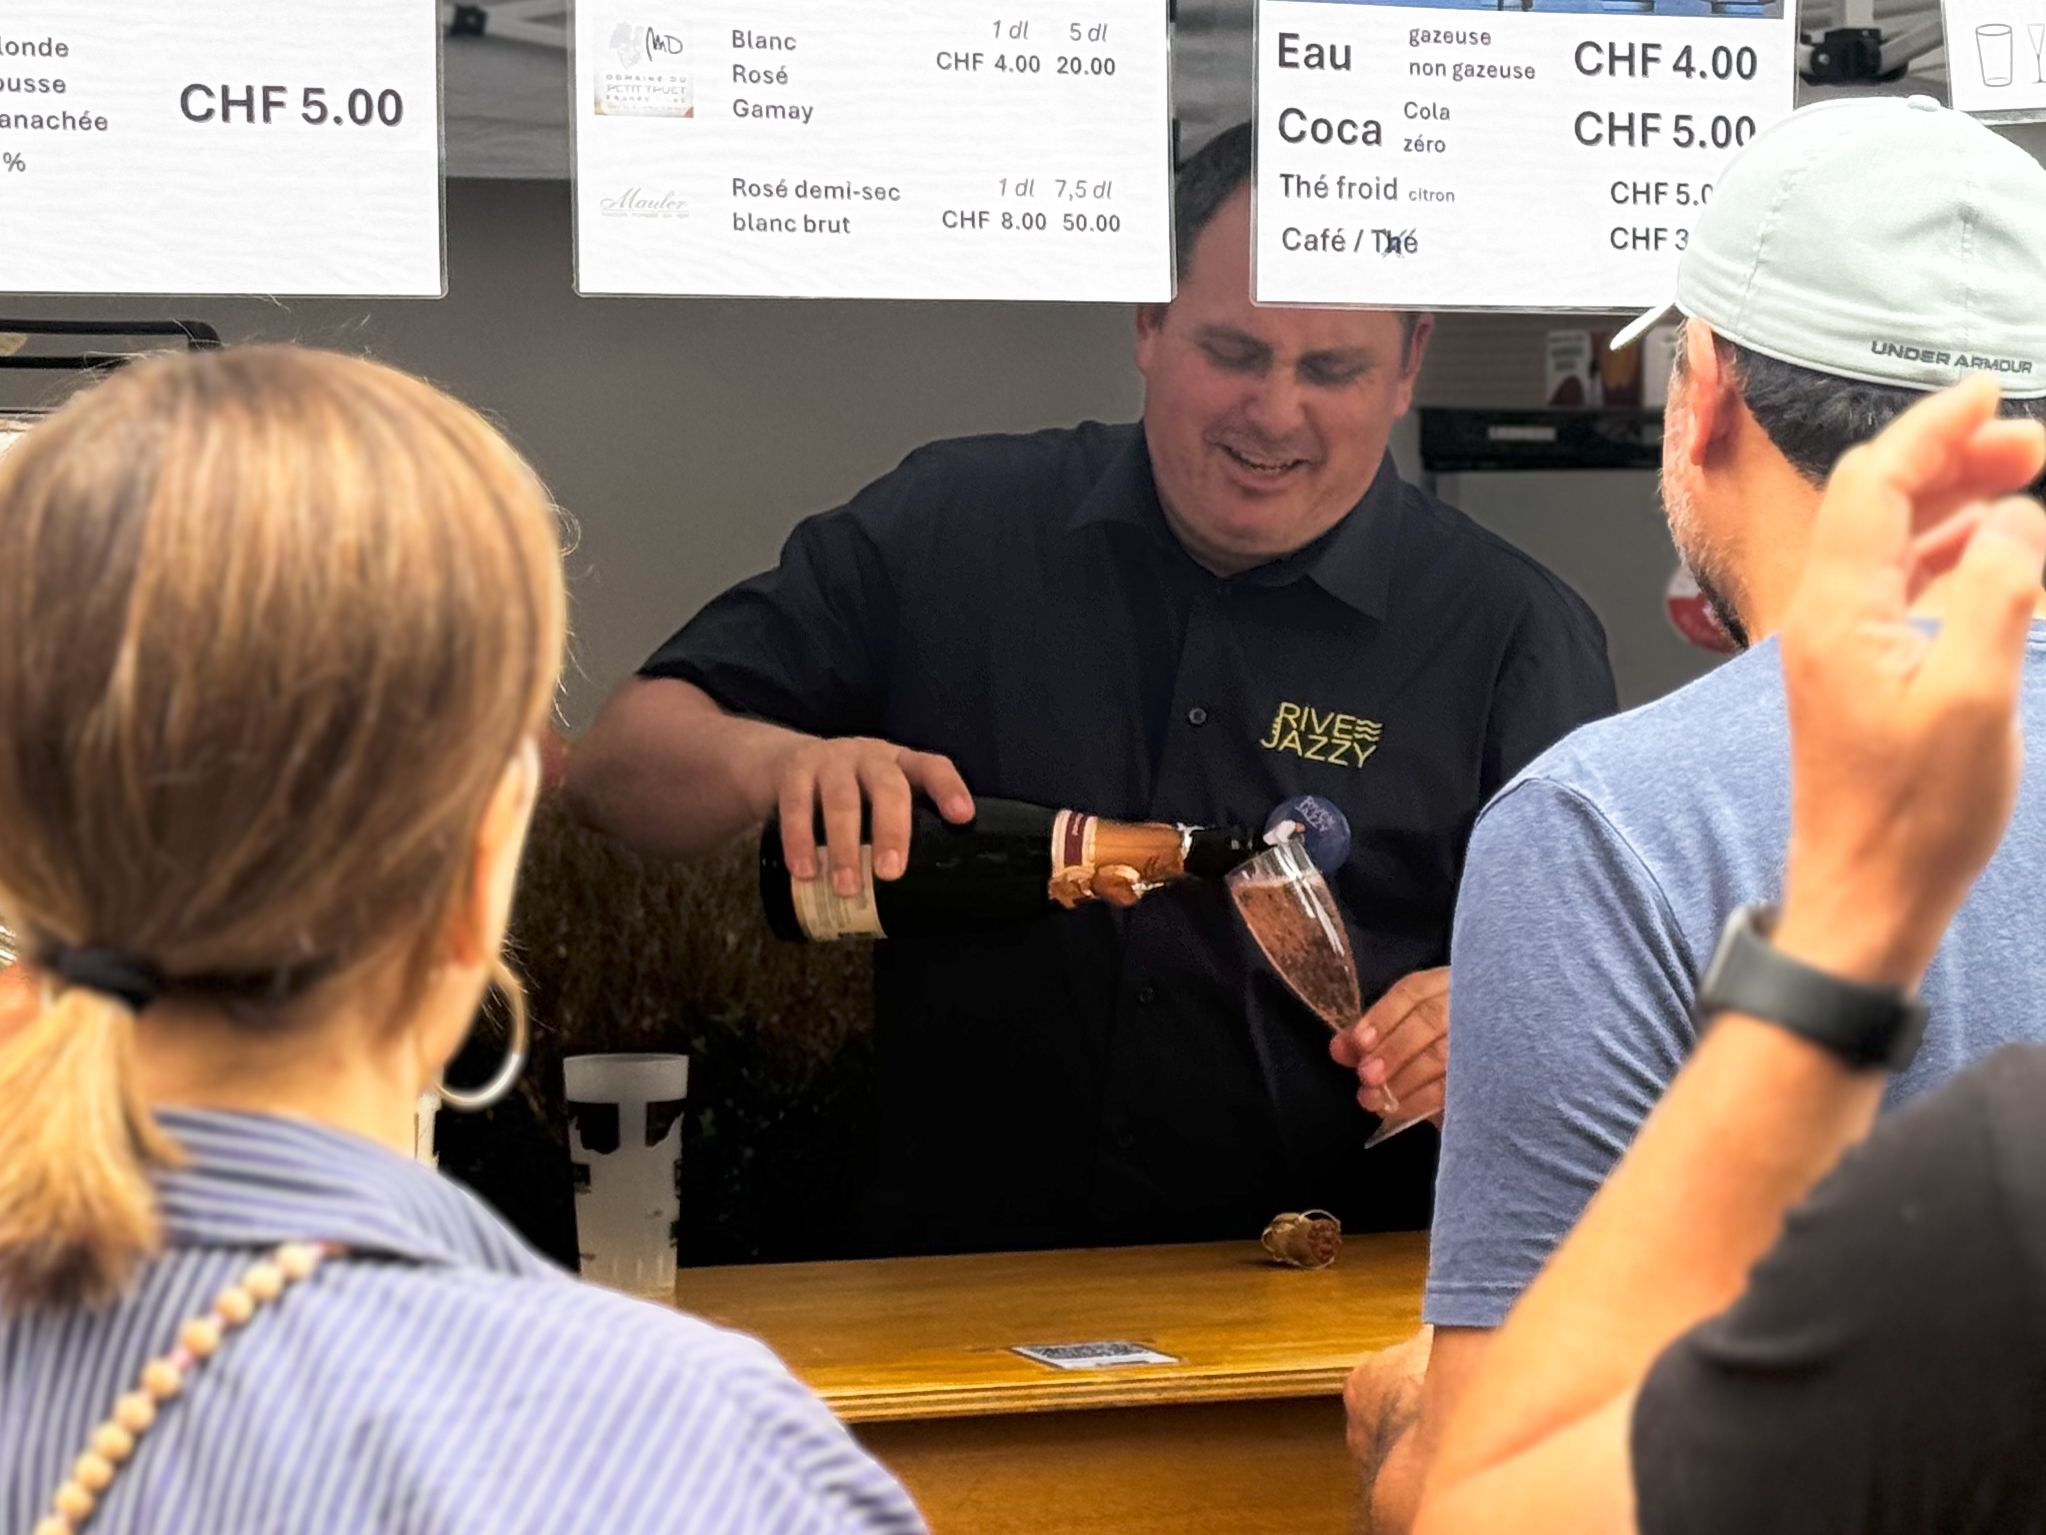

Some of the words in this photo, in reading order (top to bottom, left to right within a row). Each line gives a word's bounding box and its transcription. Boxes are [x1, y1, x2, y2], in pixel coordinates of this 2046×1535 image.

[732, 29, 796, 51] Blanc
[992, 19, 1002, 40] 1
[1008, 19, 1030, 41] dl
[1070, 22, 1082, 42] 5
[1087, 23, 1108, 43] dl
[1408, 28, 1492, 48] gazeuse
[936, 51, 984, 71] CHF
[994, 53, 1041, 73] 4.00
[1056, 55, 1116, 77] 20.00
[1278, 31, 1352, 72] Eau
[1574, 40, 1663, 78] CHF
[1672, 44, 1758, 81] 4.00
[732, 63, 788, 85] Rosé
[1409, 62, 1447, 77] non
[1452, 62, 1536, 82] gazeuse
[180, 83, 288, 124] CHF
[301, 87, 404, 127] 5.00
[732, 98, 814, 125] Gamay
[1403, 101, 1450, 121] Cola
[0, 110, 108, 132] anachée
[1278, 107, 1382, 147] Coca
[1574, 110, 1662, 148] CHF
[1672, 114, 1756, 150] 5.00
[1403, 134, 1446, 154] zéro
[732, 177, 788, 199] Rosé
[794, 179, 901, 201] demi-sec
[998, 177, 1008, 197] 1
[1014, 177, 1036, 198] dl
[1055, 179, 1087, 201] 7,5
[1092, 180, 1112, 199] dl
[1279, 173, 1329, 199] Thé
[1336, 175, 1398, 201] froid
[1408, 189, 1455, 202] citron
[1610, 180, 1669, 206] CHF
[732, 212, 797, 233] blanc
[803, 213, 850, 234] brut
[942, 209, 990, 229] CHF
[1001, 211, 1047, 231] 8.00
[1063, 213, 1121, 233] 50.00
[1282, 226, 1346, 253] Café
[1353, 229, 1364, 253] /
[1610, 226, 1668, 251] CHF
[1871, 340, 1950, 366] UNDER
[1953, 353, 2033, 374] ARMOUR
[1278, 701, 1357, 740] RIVE
[1259, 729, 1377, 769] JAZZY
